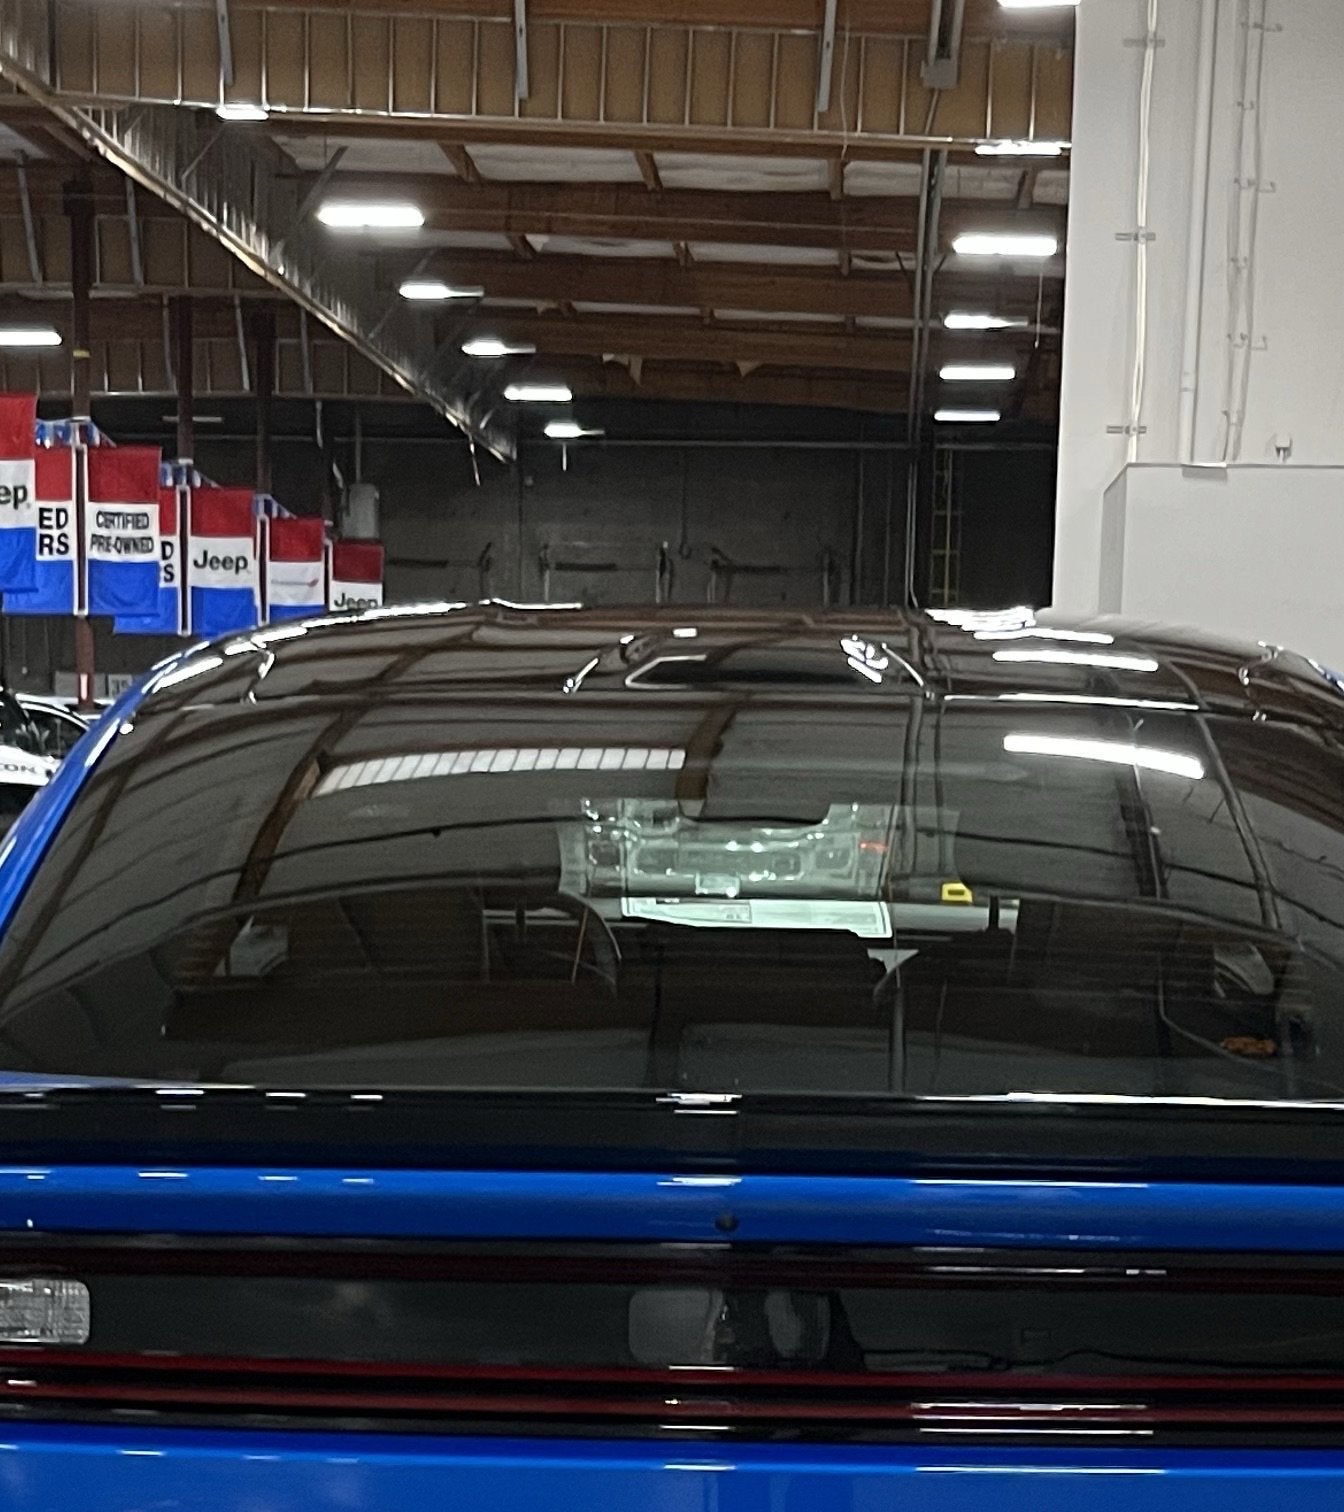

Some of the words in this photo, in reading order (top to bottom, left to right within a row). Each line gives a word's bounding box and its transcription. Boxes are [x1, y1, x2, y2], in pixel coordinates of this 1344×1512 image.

[38, 507, 69, 529] ED
[96, 510, 150, 530] CERTIFIED
[38, 533, 70, 556] RS
[90, 534, 155, 554] PRE-OWNED
[193, 550, 248, 574] Jeep
